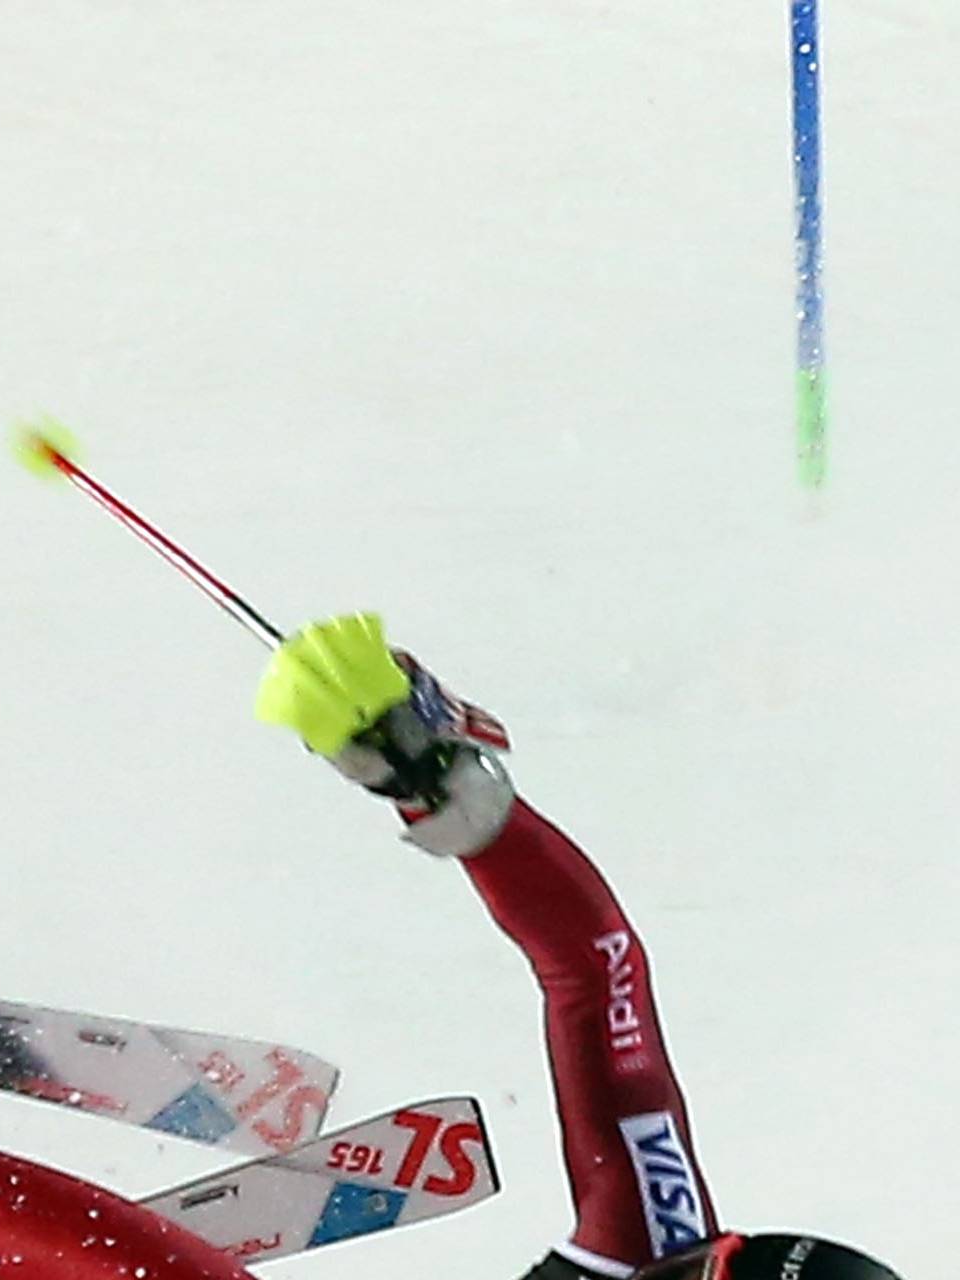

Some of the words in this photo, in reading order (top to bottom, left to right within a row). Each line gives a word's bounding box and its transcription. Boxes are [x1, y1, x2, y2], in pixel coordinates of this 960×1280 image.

[594, 931, 642, 1050] Audi
[326, 1142, 384, 1175] 165
[393, 1110, 483, 1197] SL
[637, 1120, 700, 1250] VISA
